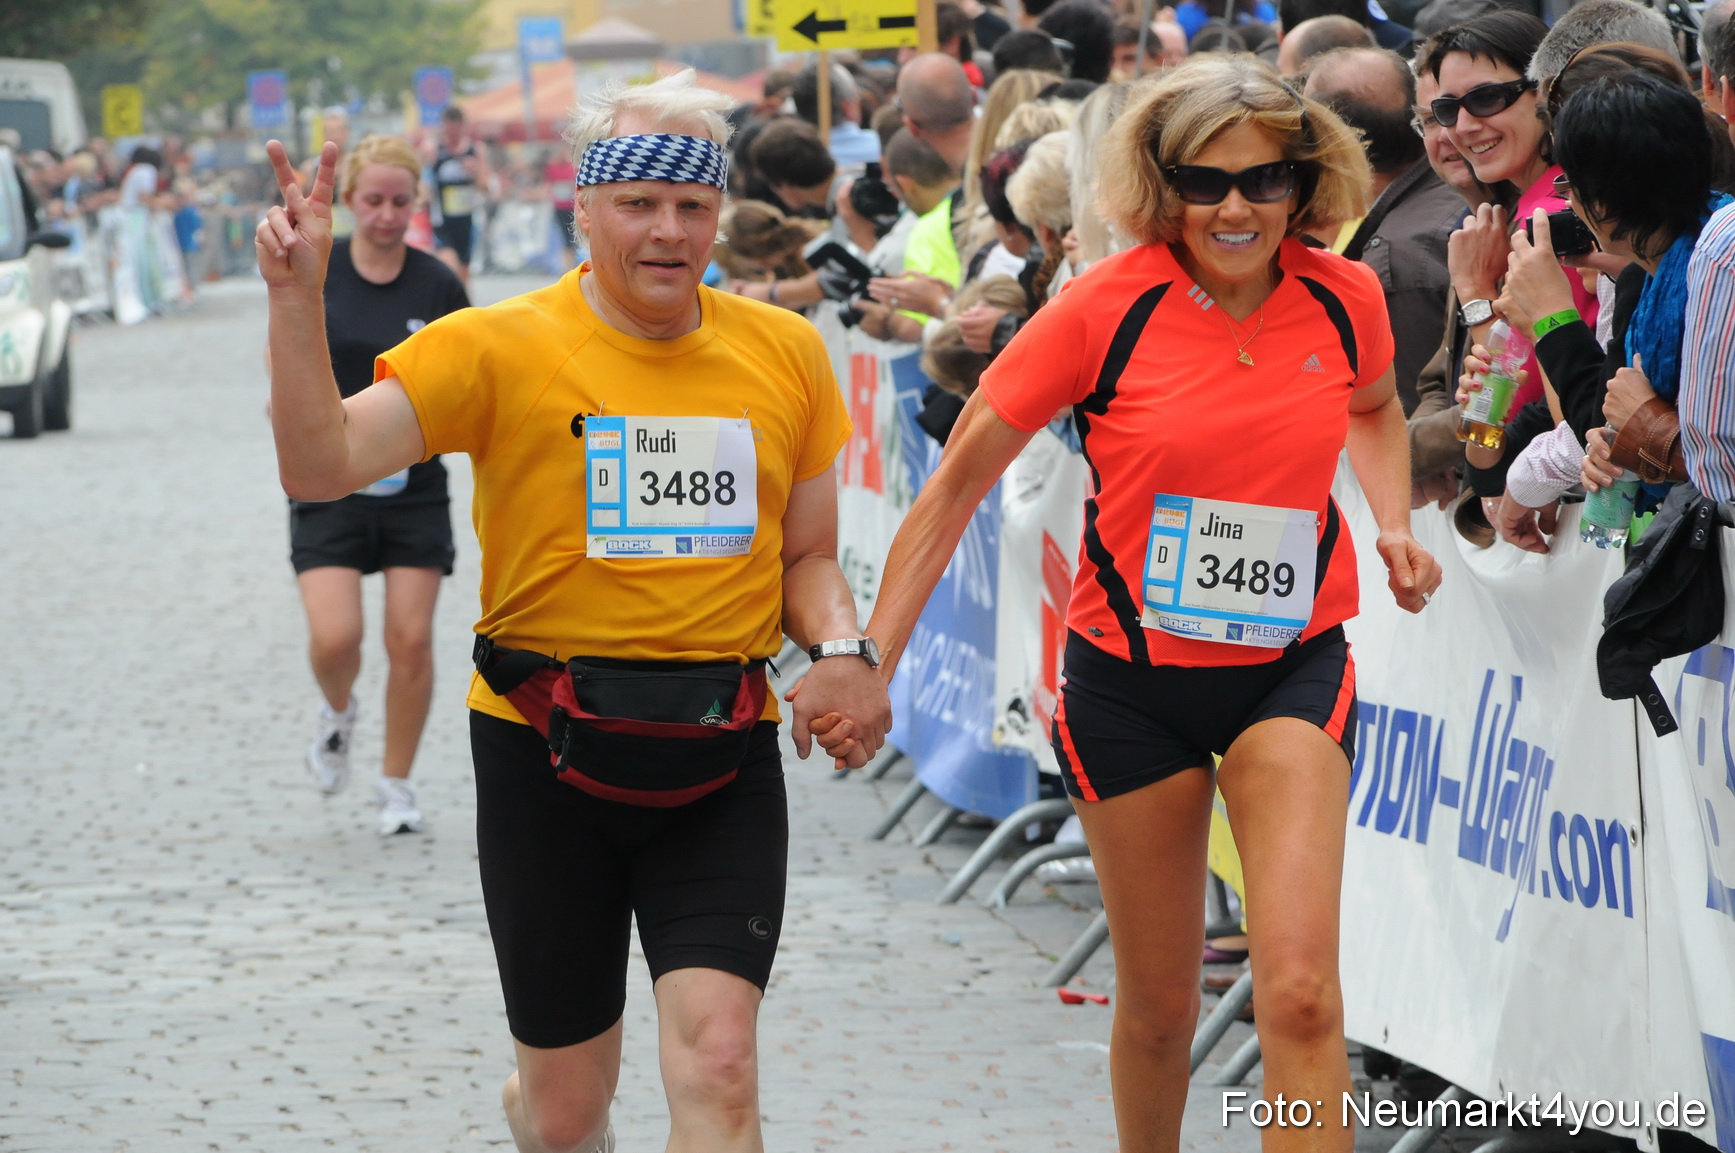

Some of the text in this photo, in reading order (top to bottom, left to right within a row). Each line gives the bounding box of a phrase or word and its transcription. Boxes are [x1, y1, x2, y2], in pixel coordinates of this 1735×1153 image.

[636, 428, 677, 453] Rudi
[598, 468, 609, 487] D
[639, 470, 737, 506] 3488
[1200, 512, 1244, 540] Jina
[606, 539, 652, 550] BOCK
[694, 535, 752, 547] PFLEIDERER
[1157, 545, 1169, 564] D
[1196, 553, 1296, 598] 3489
[1158, 615, 1202, 632] BOCK
